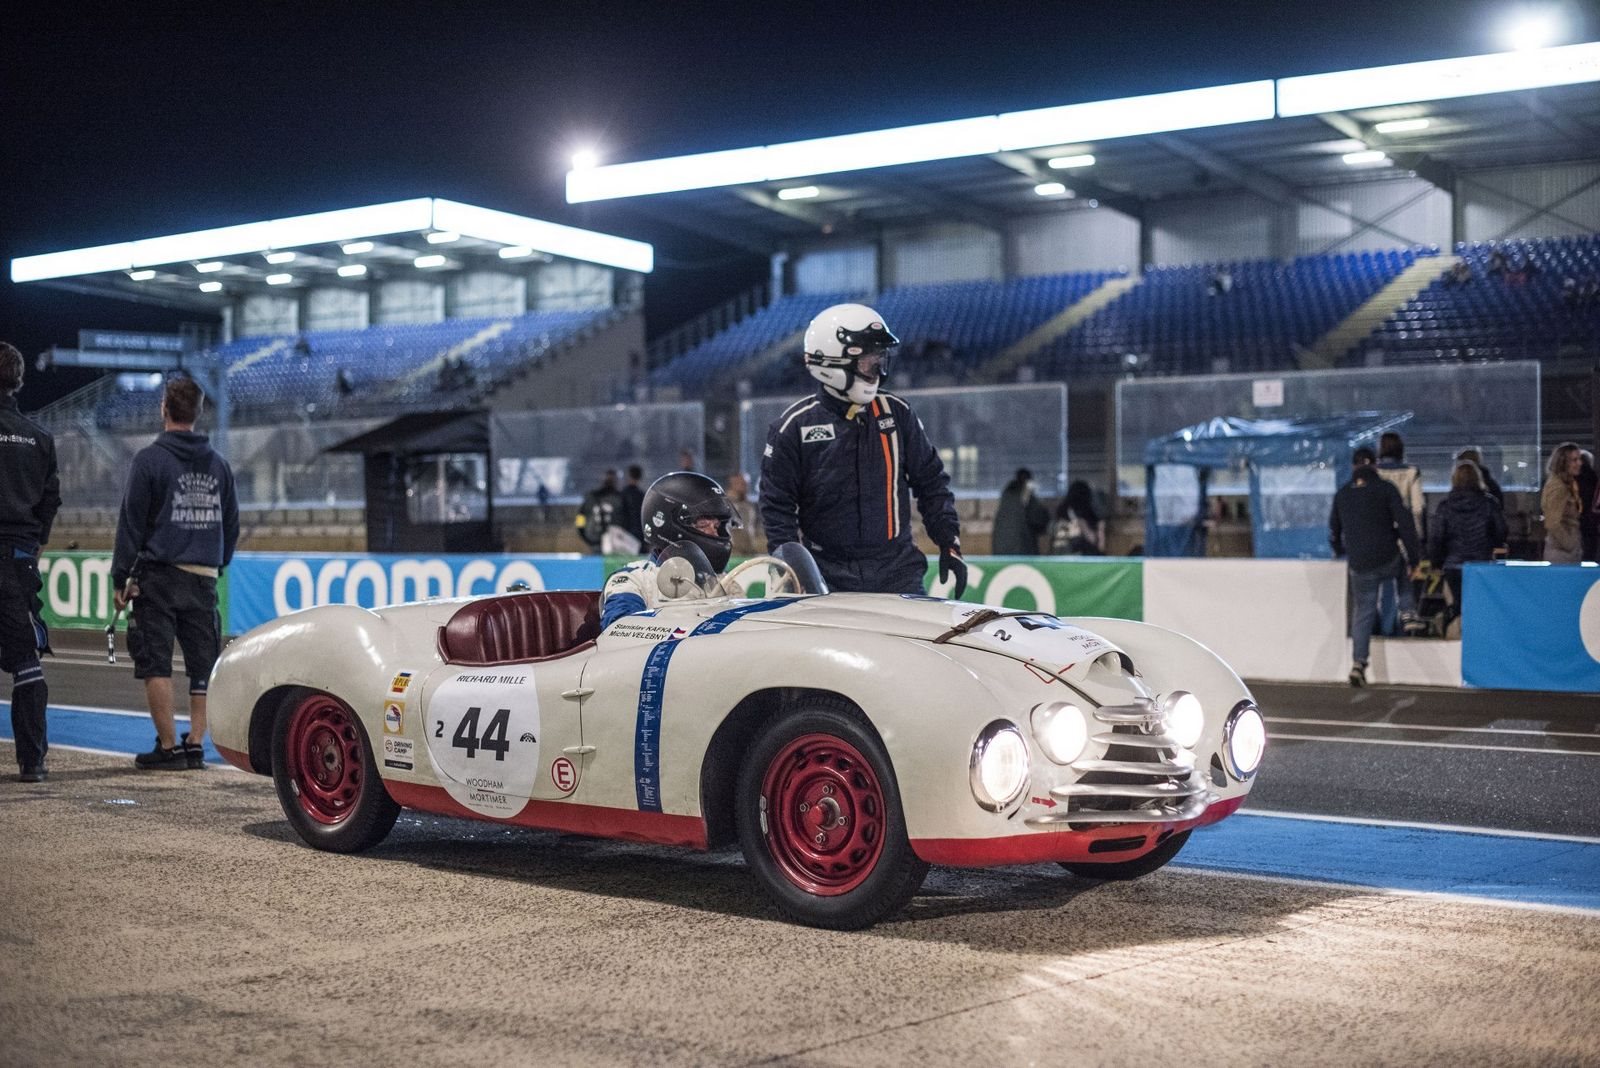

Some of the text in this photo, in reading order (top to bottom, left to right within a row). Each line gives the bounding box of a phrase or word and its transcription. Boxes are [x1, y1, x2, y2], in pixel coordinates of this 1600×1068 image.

[608, 630, 632, 638] Michal
[646, 625, 672, 633] KAFKA
[993, 629, 1012, 642] 2
[456, 675, 527, 685] RICHARD MILLE
[435, 707, 511, 761] 2 44
[394, 741, 412, 750] DRIVING
[394, 747, 407, 755] CAMP
[557, 763, 570, 784] E
[466, 778, 504, 790] WOODHAM
[469, 793, 507, 804] MORTIMER
